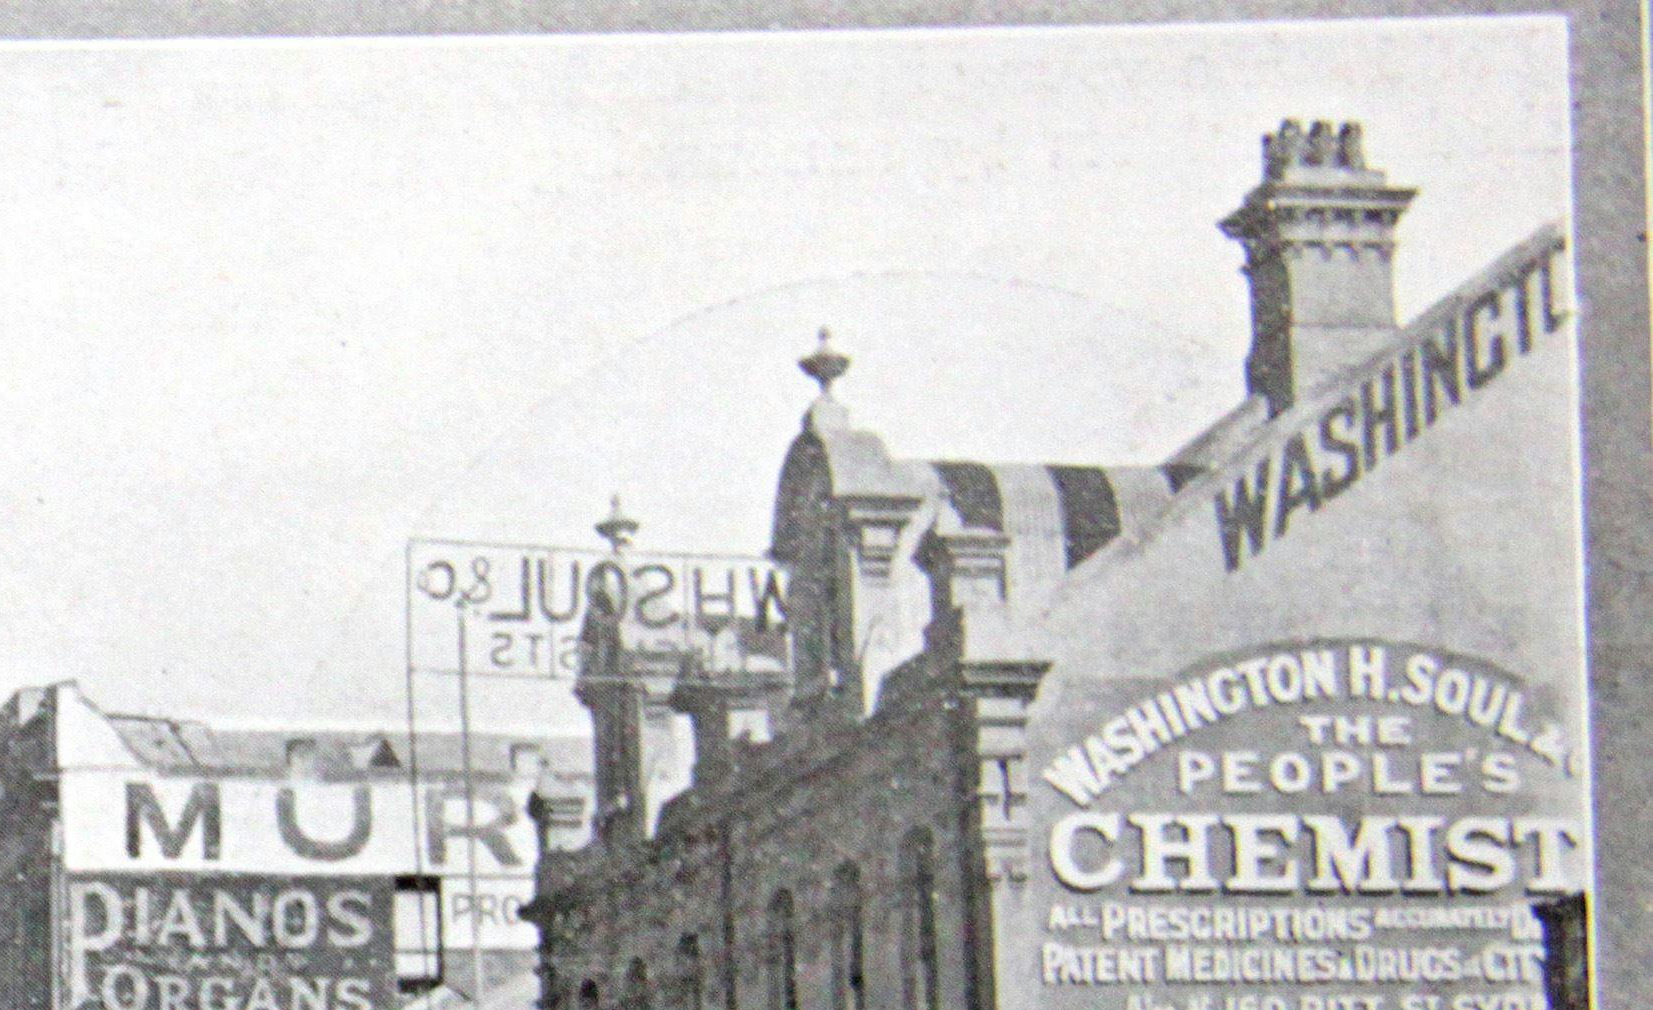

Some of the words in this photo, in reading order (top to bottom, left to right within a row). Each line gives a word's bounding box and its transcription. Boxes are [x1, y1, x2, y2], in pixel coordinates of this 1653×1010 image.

[1045, 649, 1336, 806] WASHINGTON
[1301, 715, 1412, 746] THE
[1179, 748, 1523, 795] PEOPLE'S
[1101, 902, 1372, 941] PRESCRIPTIONS
[68, 880, 376, 1010] PIANOS
[1042, 942, 1161, 984] PATENT
[1164, 943, 1336, 983] MEDICINES
[1353, 945, 1462, 982] DRUGS
